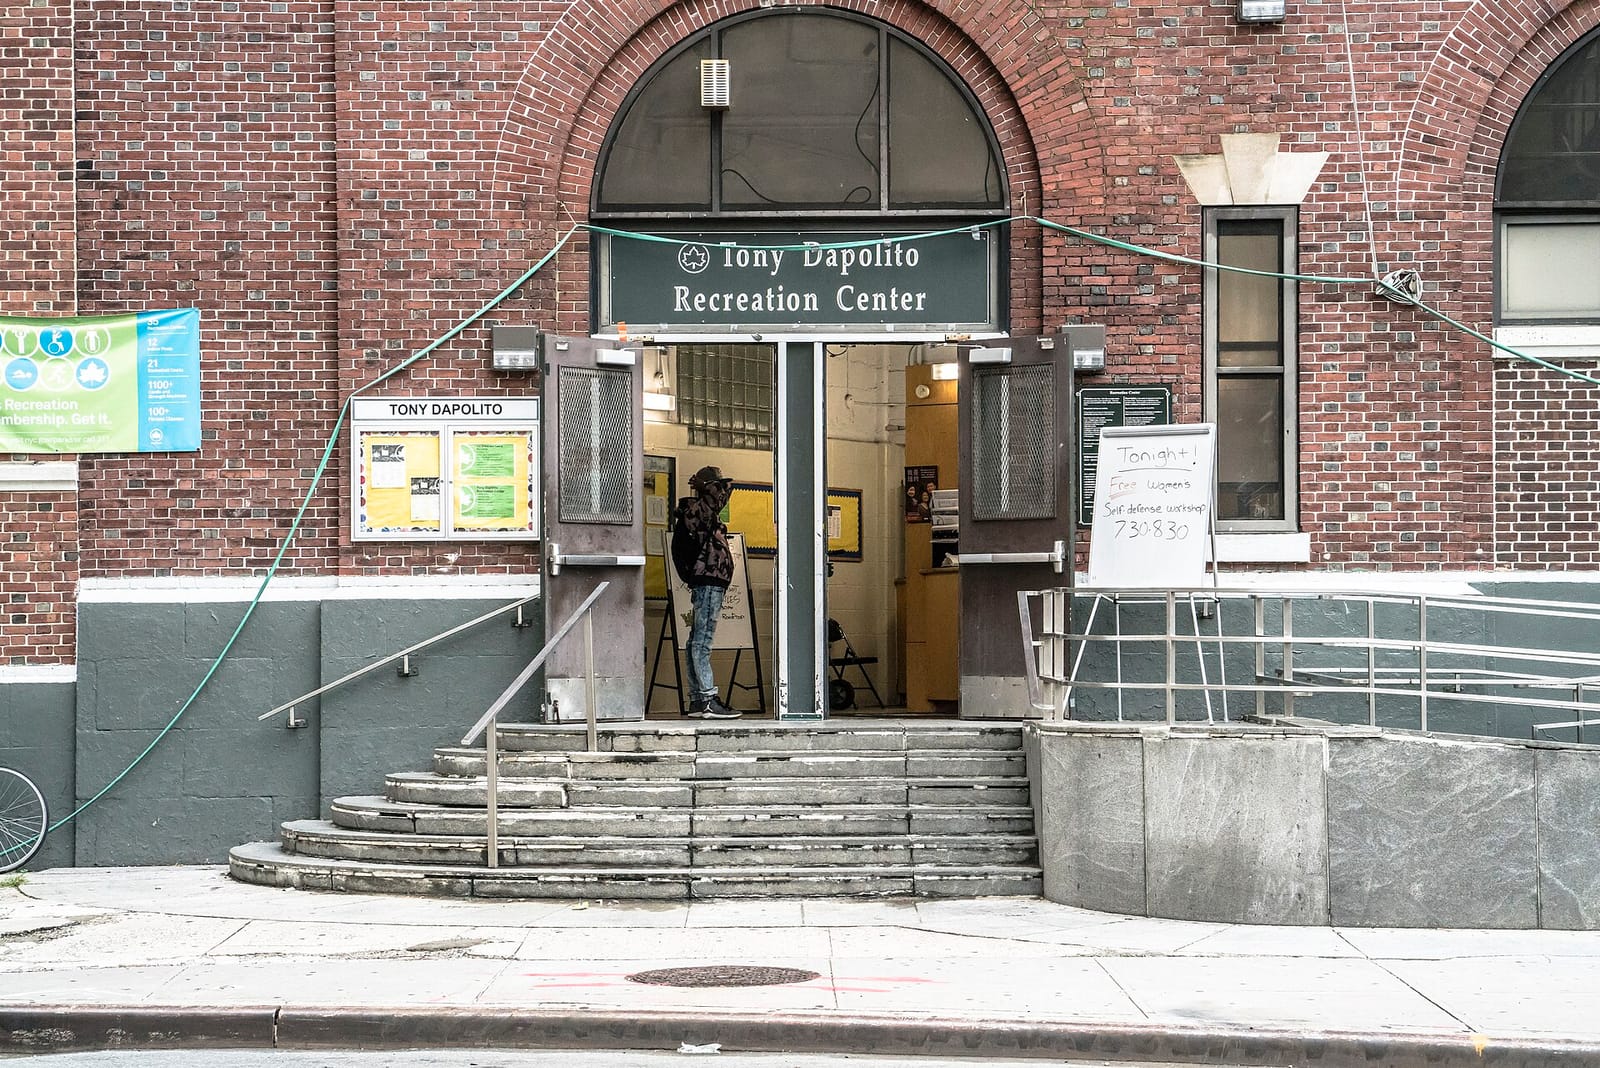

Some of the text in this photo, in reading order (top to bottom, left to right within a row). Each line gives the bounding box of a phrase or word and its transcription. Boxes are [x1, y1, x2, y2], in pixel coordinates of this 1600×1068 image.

[720, 242, 919, 276] Tony Dapolito
[673, 284, 927, 312] Recreation Center
[147, 338, 158, 347] 12
[147, 359, 158, 368] 21
[4, 398, 79, 411] Recreation
[389, 403, 503, 416] TONY DAPOLITO
[0, 412, 68, 428] mbership.
[71, 412, 96, 426] Get
[1116, 444, 1198, 468] Tonight!
[1110, 476, 1137, 496] Free
[1166, 502, 1207, 515] workshop
